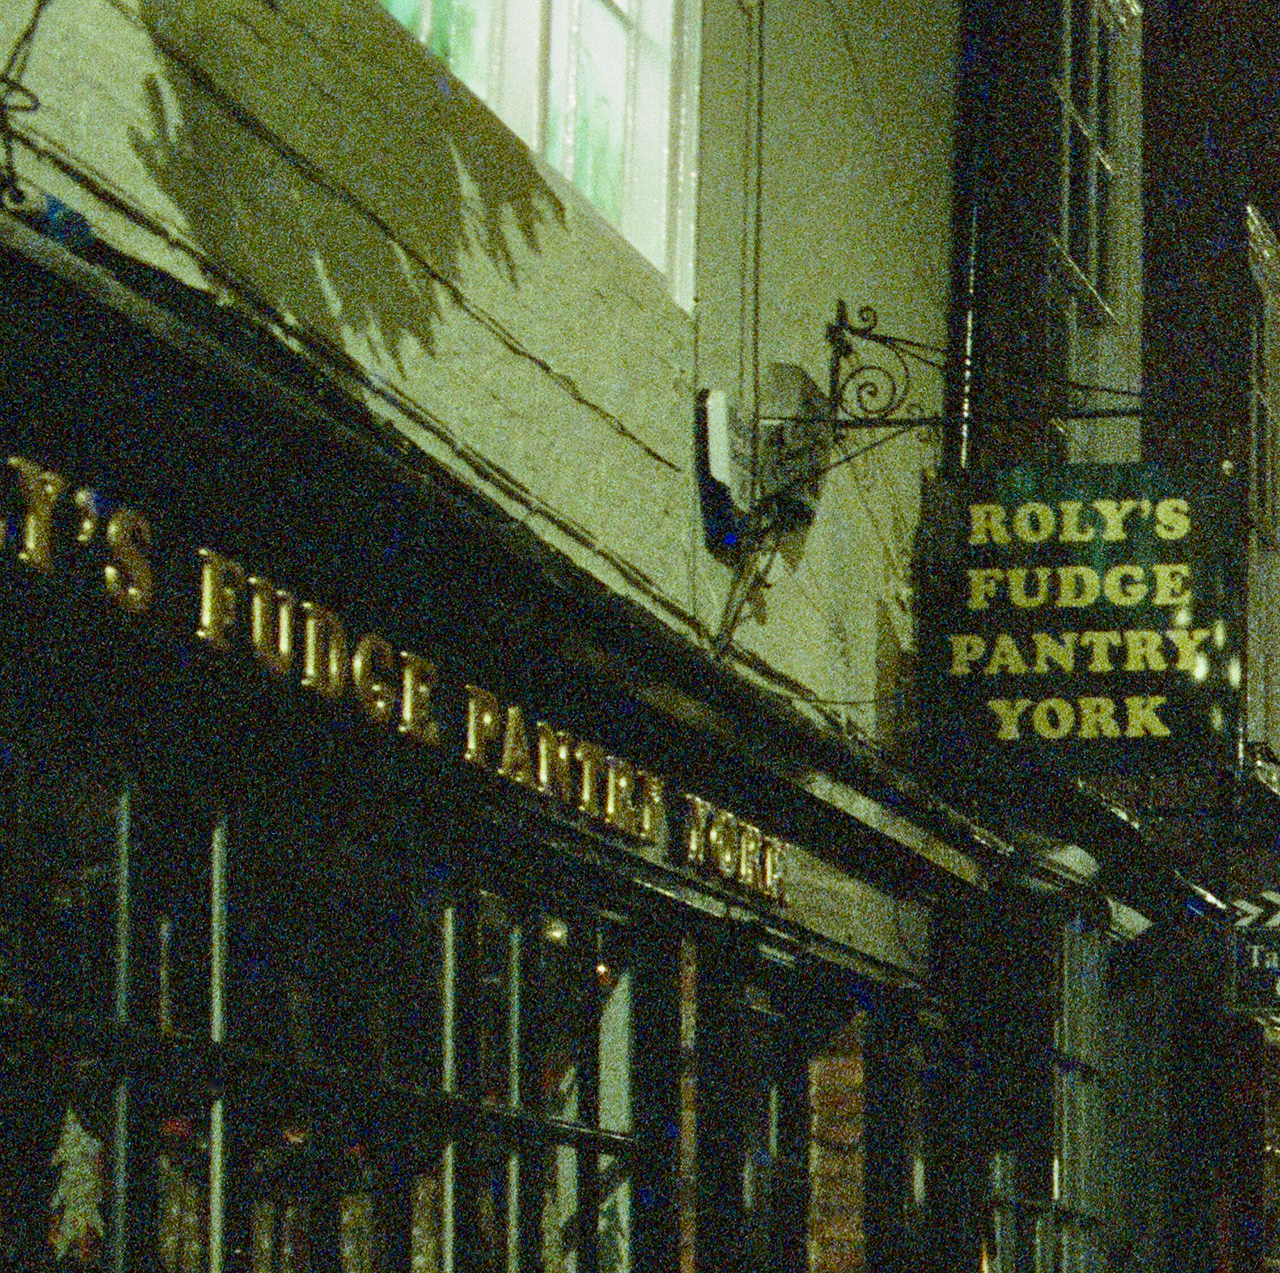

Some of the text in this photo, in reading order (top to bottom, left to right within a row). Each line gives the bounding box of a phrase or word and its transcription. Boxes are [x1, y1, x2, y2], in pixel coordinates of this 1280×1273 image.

[968, 497, 1193, 545] ROLY'S
[966, 563, 1193, 611] FUDGE
[948, 628, 1210, 676] PANTRY
[0, 455, 787, 905] Y'S FUDGE PANTRY YORK
[985, 694, 1171, 741] YORK
